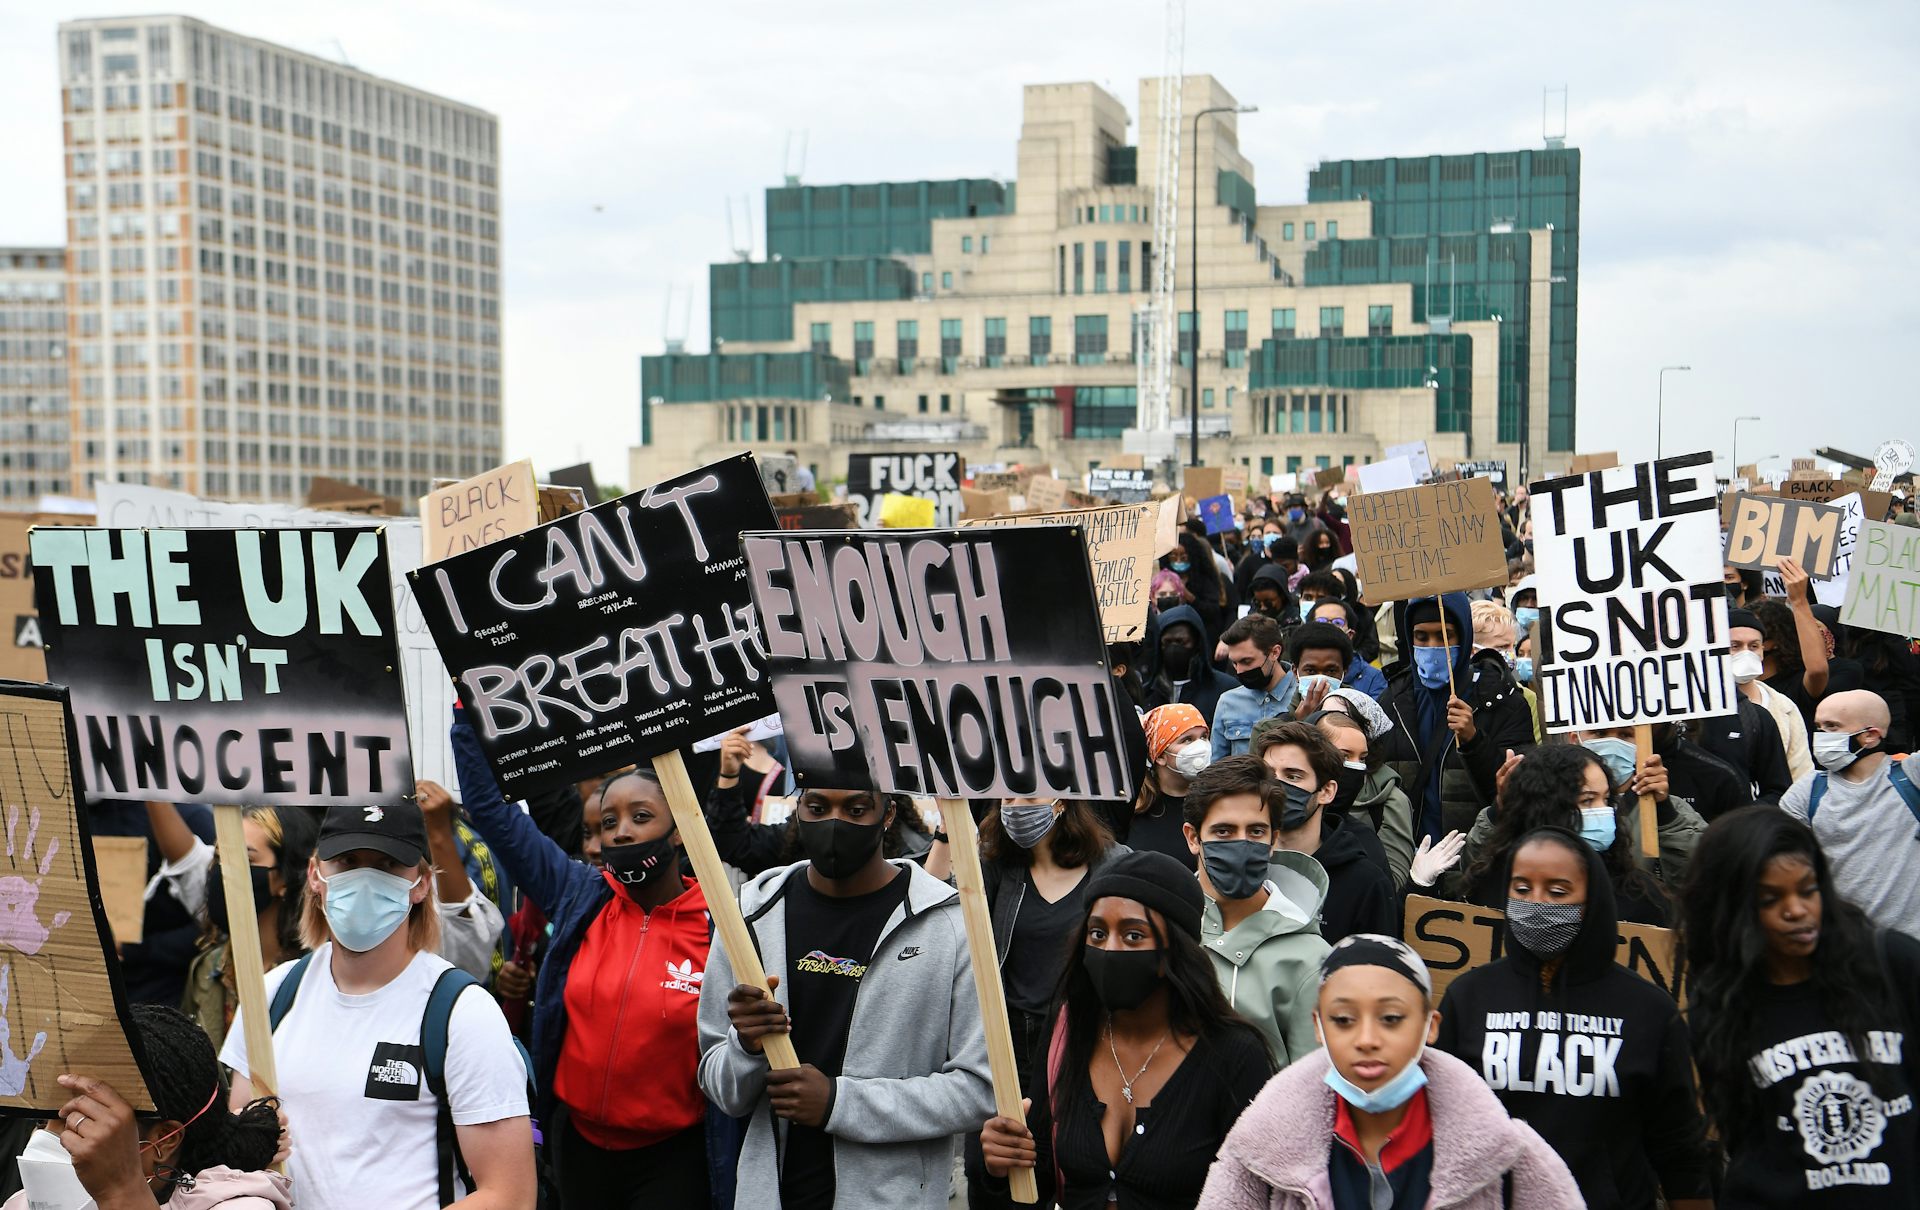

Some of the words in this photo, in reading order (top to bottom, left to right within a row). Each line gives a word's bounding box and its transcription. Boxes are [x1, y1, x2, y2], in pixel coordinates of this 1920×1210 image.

[870, 453, 958, 491] FUCK
[1791, 480, 1835, 494] BLACK
[441, 476, 520, 528] BLACK
[848, 490, 962, 528] RAM
[1353, 489, 1430, 522] HOPEFUL
[1434, 482, 1475, 515] FOR
[1530, 450, 1717, 536] THE
[1091, 509, 1141, 543] MARTIN
[1357, 520, 1430, 553] CHANGE
[1438, 516, 1460, 546] IN
[1461, 513, 1485, 543] MY
[1728, 497, 1839, 576] BLM
[435, 568, 468, 633] I
[490, 474, 719, 611] CAN'T
[705, 556, 744, 574] AHMAUD
[1095, 557, 1136, 583] TAYLOR
[1360, 547, 1456, 584] LIFETIME
[1574, 521, 1684, 595] UK
[30, 530, 201, 628] THE
[235, 530, 383, 637] UK
[577, 591, 618, 609] BREONNA
[745, 539, 1011, 667] ENOUGH
[600, 597, 637, 614] TAYLOR.
[1538, 600, 1600, 665] IS
[1607, 581, 1727, 657] NOT
[474, 621, 508, 639] GEORGE
[491, 632, 519, 646] FLOYD.
[145, 634, 288, 702] ISN'T
[1542, 647, 1732, 728] INNOCENT
[497, 748, 528, 765] STEPHEN
[531, 736, 567, 753] LAWRENCE,
[576, 728, 596, 741] MARK
[598, 720, 627, 733] DUGGAN,
[635, 707, 665, 722] DAMILOLA
[664, 698, 691, 713] TAYLOR,
[704, 692, 724, 702] FARUK
[503, 767, 525, 781] BELLY
[578, 744, 603, 758] RASHAN
[641, 724, 662, 737] SARAH
[666, 716, 689, 729] REED,
[704, 705, 724, 716] JULIAN
[802, 680, 856, 751] IS
[869, 674, 1124, 797] ENOUGH
[76, 713, 391, 797] NNOCENT
[903, 946, 920, 955] NIKE
[1485, 1011, 1624, 1035] UNAPOOGTICALLY
[371, 1065, 403, 1077] NORTH
[378, 1073, 402, 1084] FACE
[386, 1059, 404, 1069] THE
[1482, 1031, 1623, 1097] BLACK
[1747, 1031, 1903, 1089] MSTERAM
[1805, 1162, 1891, 1190] HOLLAND
